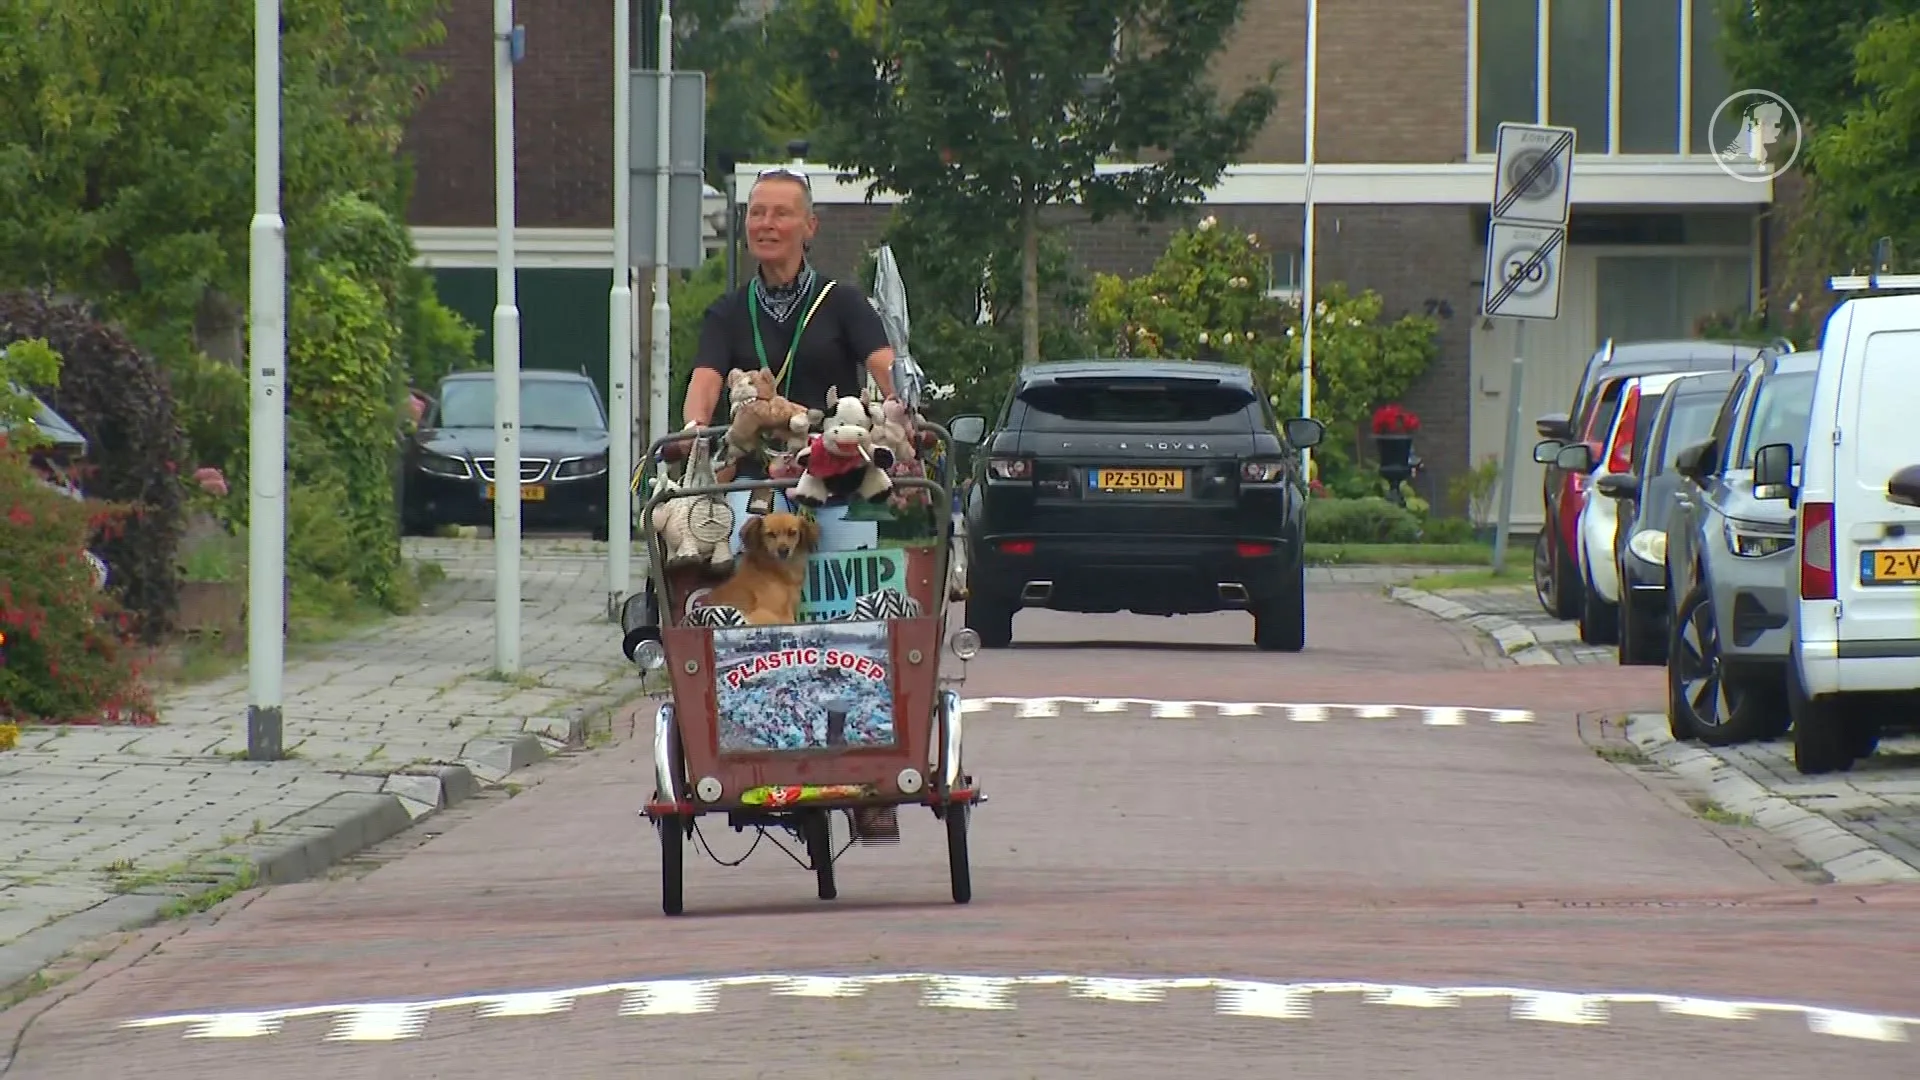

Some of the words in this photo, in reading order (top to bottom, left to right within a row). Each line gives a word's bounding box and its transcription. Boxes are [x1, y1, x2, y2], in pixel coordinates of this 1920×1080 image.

[1105, 471, 1175, 487] PZ-510-N
[726, 649, 819, 690] PLASTIC
[825, 649, 886, 682] SOEP
